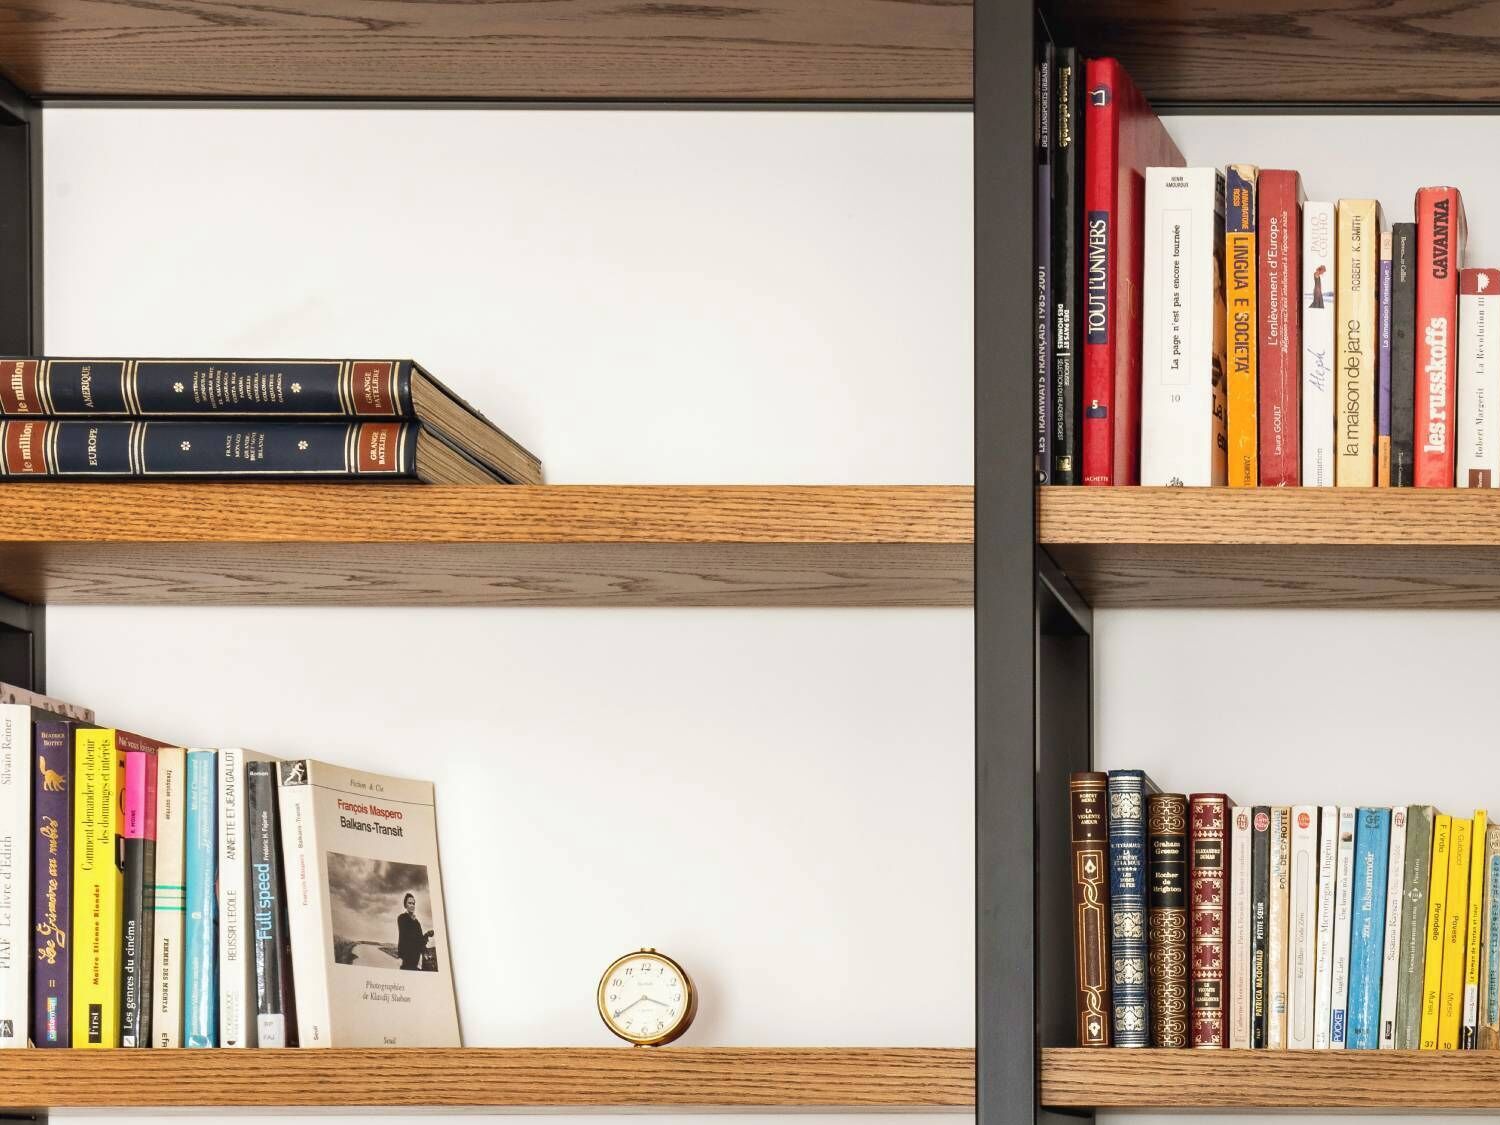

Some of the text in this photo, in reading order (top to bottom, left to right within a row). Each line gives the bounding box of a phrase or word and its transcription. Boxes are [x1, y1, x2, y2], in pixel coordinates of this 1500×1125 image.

[1041, 63, 1049, 93] URBAINS
[1041, 96, 1049, 132] TRANSPORTS
[1172, 225, 1180, 257] tournée
[1353, 216, 1361, 291] ROBERT K. SMITH
[1433, 199, 1449, 279] CAVANNA
[1234, 237, 1249, 289] LINGUA
[1267, 217, 1279, 345] L'enlèvement d'Europe
[1088, 293, 1106, 334] TOUT
[1173, 293, 1181, 306] pas
[1235, 298, 1249, 306] E
[1172, 359, 1179, 369] La
[1173, 335, 1181, 355] page
[12, 362, 28, 412] le million
[1344, 320, 1361, 456] la maison de jane
[1424, 318, 1447, 453] les russkoffs
[19, 423, 33, 472] le million
[89, 428, 98, 466] EUROPE
[81, 739, 96, 871] Comment demander et obtenir
[98, 740, 111, 844] des dommages et intérêts
[338, 799, 403, 820] François Maspero
[340, 816, 403, 837] Balkans-Transit
[254, 863, 274, 940] Full speed
[1256, 922, 1264, 939] PETITE
[124, 921, 136, 1029] Les genres du cinéma
